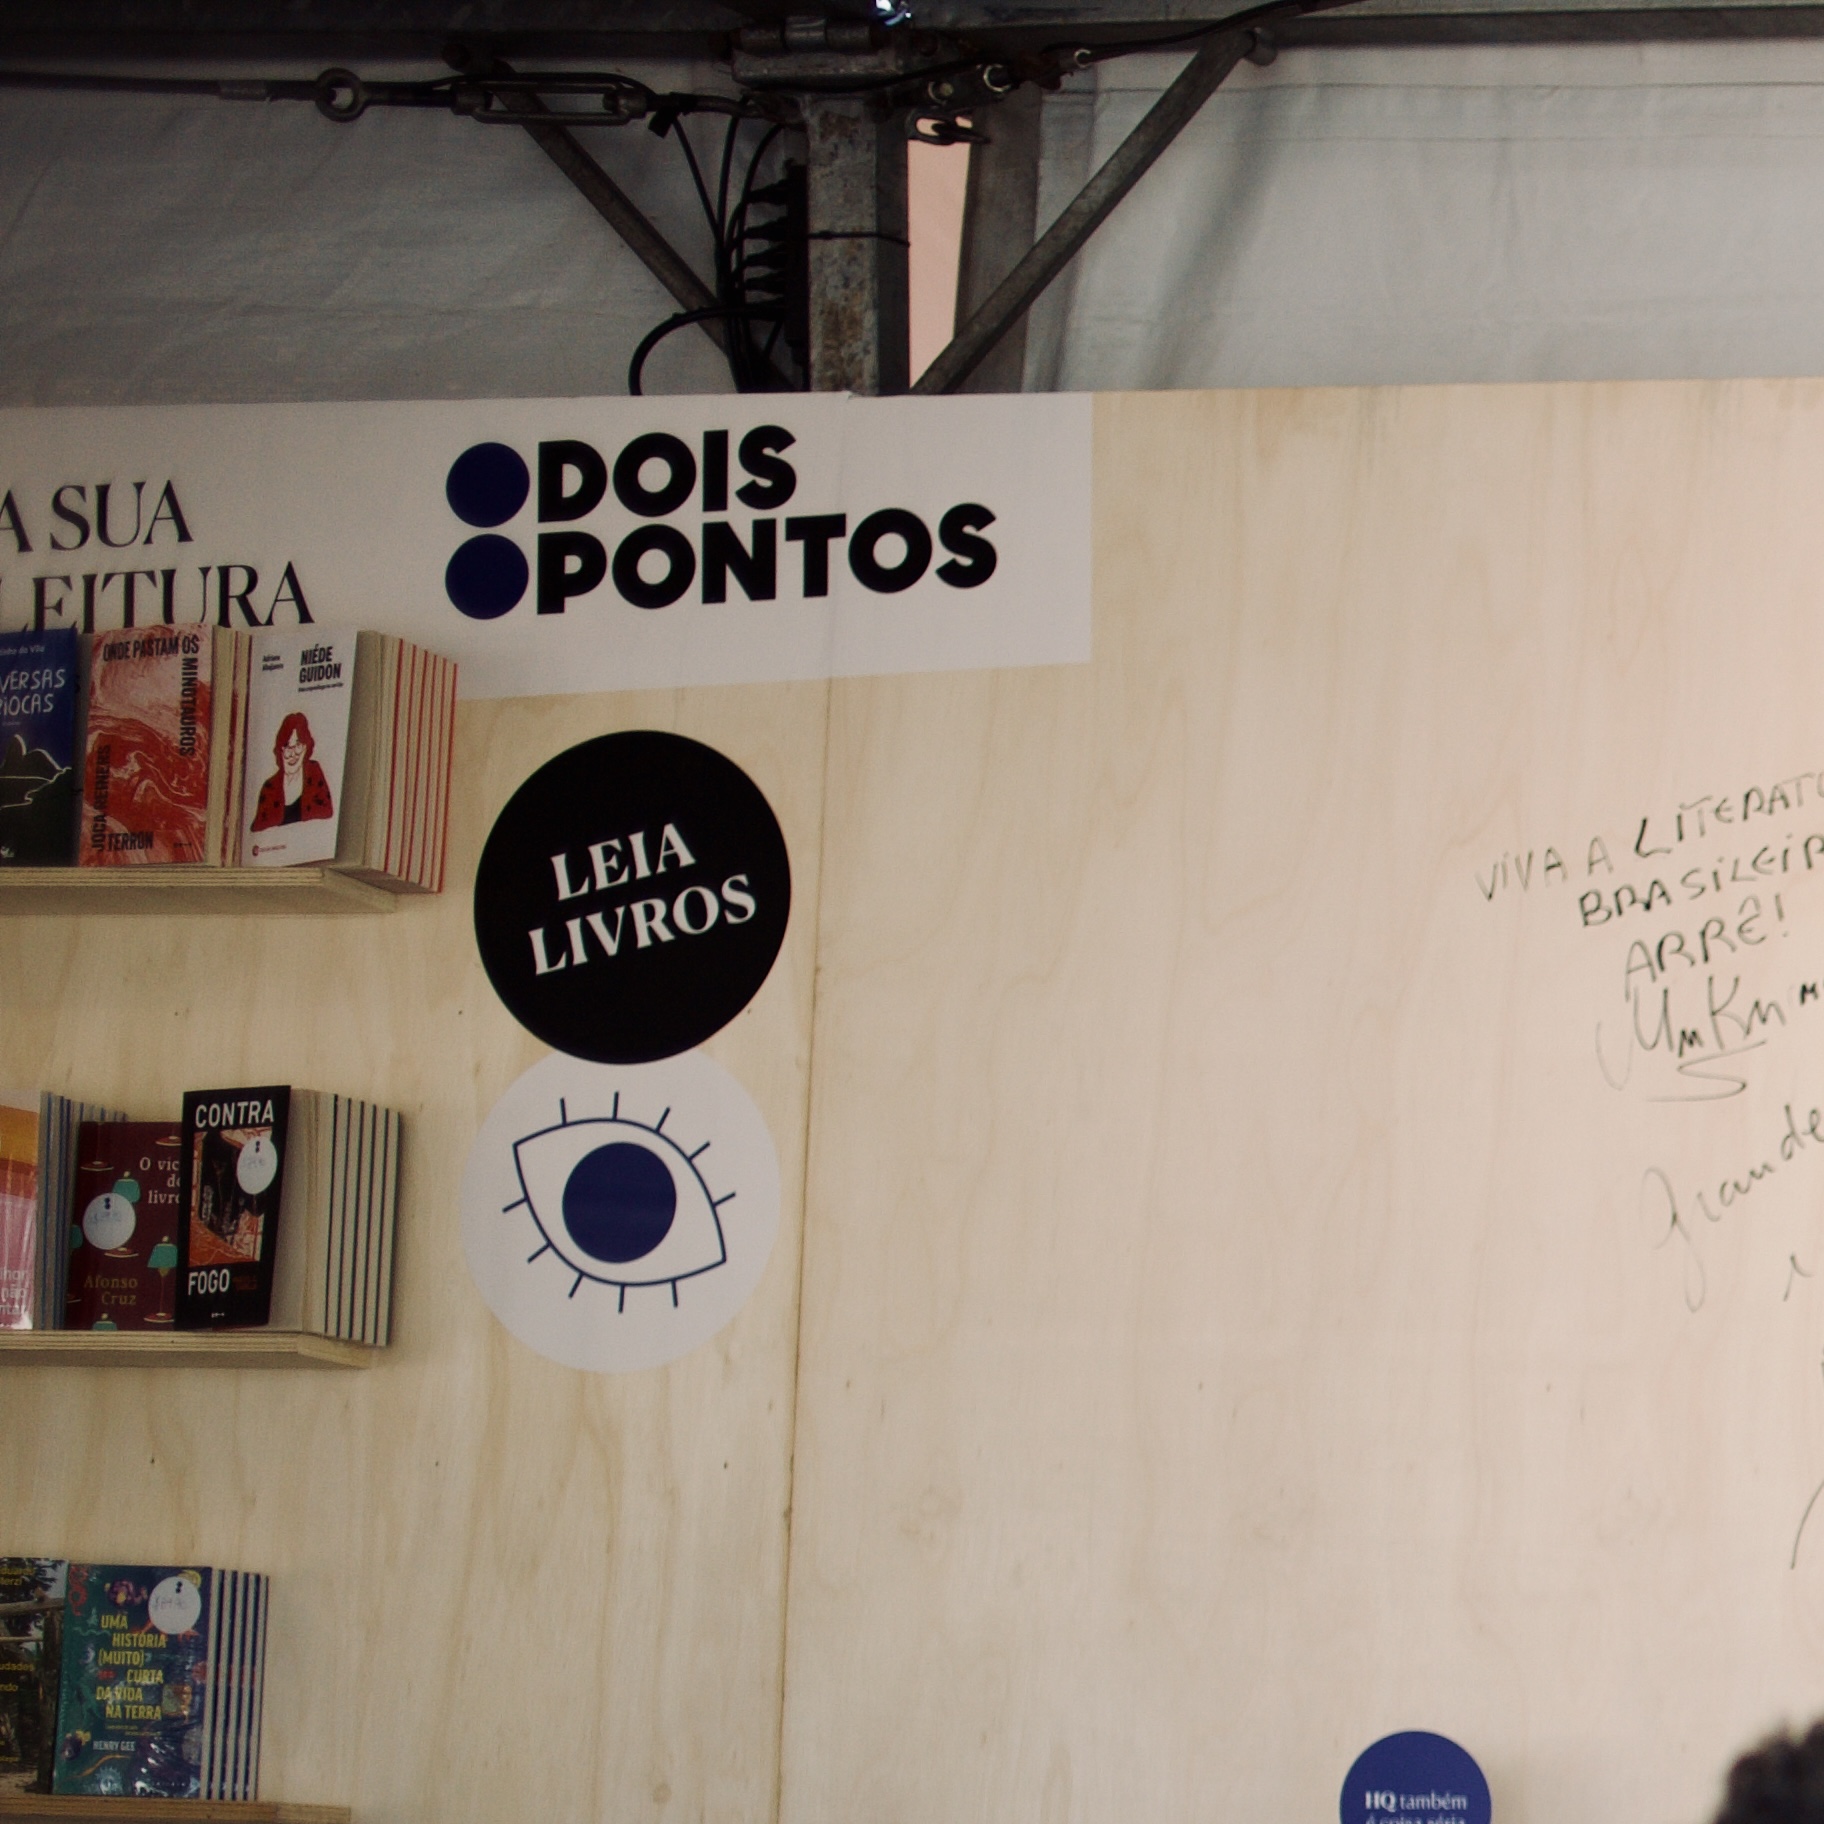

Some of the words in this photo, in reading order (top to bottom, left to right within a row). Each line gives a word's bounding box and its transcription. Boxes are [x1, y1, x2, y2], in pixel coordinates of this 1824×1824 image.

[537, 425, 797, 523] DOIS
[0, 489, 33, 553] A
[50, 479, 194, 551] SUA
[537, 503, 998, 615] PONTOS
[103, 640, 130, 661] ONDE
[133, 636, 179, 659] PASTAM
[181, 634, 199, 655] OS
[300, 644, 333, 665] NIÉDE
[299, 663, 342, 683] GUIDON
[180, 657, 198, 757] MINOTAUROS
[107, 831, 154, 851] TERRON
[551, 822, 697, 901] LEIA
[1475, 845, 1569, 903] VIVA
[1587, 836, 1614, 876] A
[528, 873, 757, 976] LIVROS
[195, 1099, 275, 1129] CONTRA
[140, 1157, 150, 1171] O
[84, 1275, 138, 1289] Afonso
[188, 1268, 230, 1296] FOGO
[102, 1291, 137, 1306] Cruz
[101, 1615, 128, 1630] UMA
[112, 1631, 167, 1648] HISTÓRIA
[98, 1649, 145, 1668] (MUITO)
[96, 1686, 112, 1701] DA
[115, 1686, 143, 1701] VIDA
[105, 1704, 122, 1719] NA
[124, 1705, 162, 1720] TERRA
[1364, 1790, 1397, 1813] HQ
[1400, 1789, 1468, 1811] também
